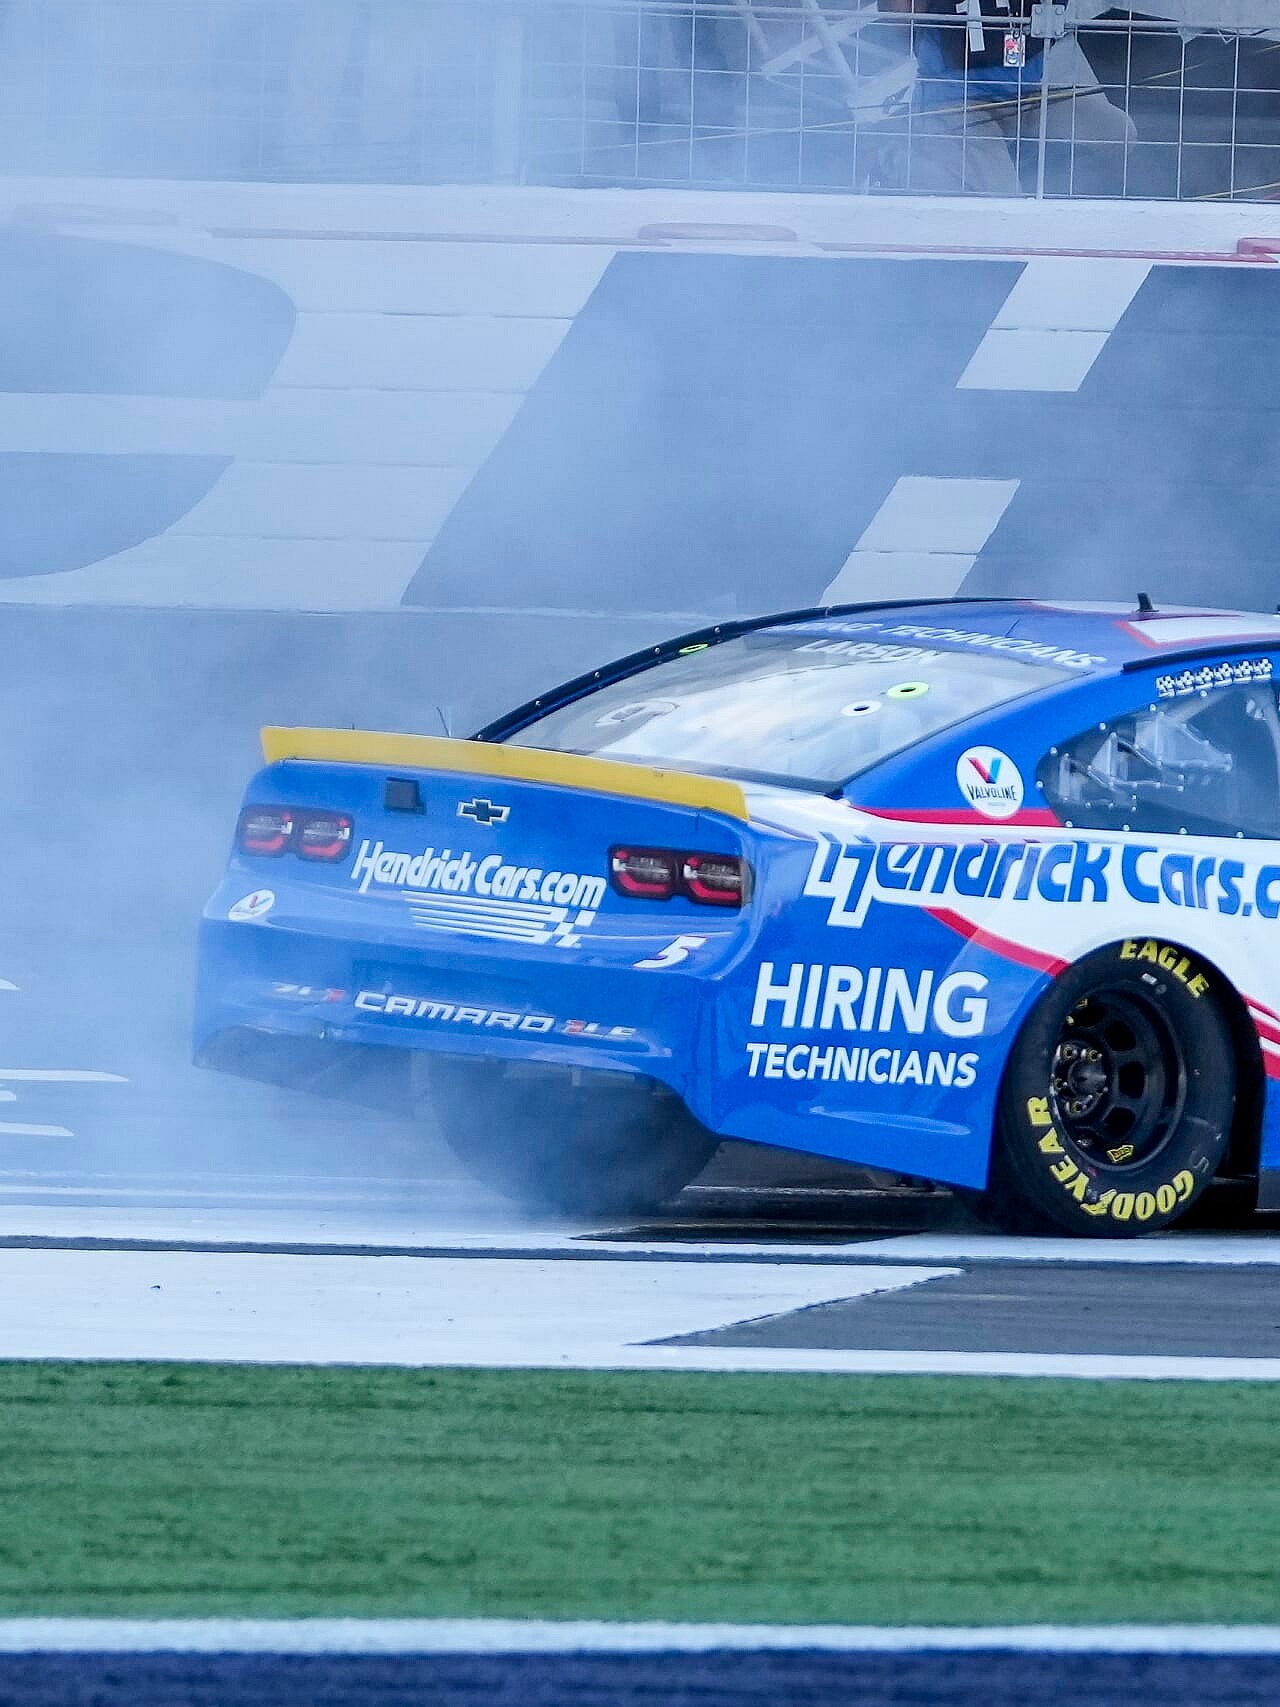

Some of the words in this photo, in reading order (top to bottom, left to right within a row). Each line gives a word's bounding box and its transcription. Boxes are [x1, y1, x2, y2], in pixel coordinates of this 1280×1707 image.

[879, 625, 1107, 667] TECHNICIANS
[966, 783, 1018, 801] VALVOLINE
[632, 935, 707, 969] 5
[1120, 938, 1210, 999] EAGLE
[354, 990, 555, 1034] CAMARO
[750, 962, 990, 1038] HIRING
[746, 1042, 980, 1089] TECHNICIANS
[1026, 1096, 1195, 1222] GOODYEAR
